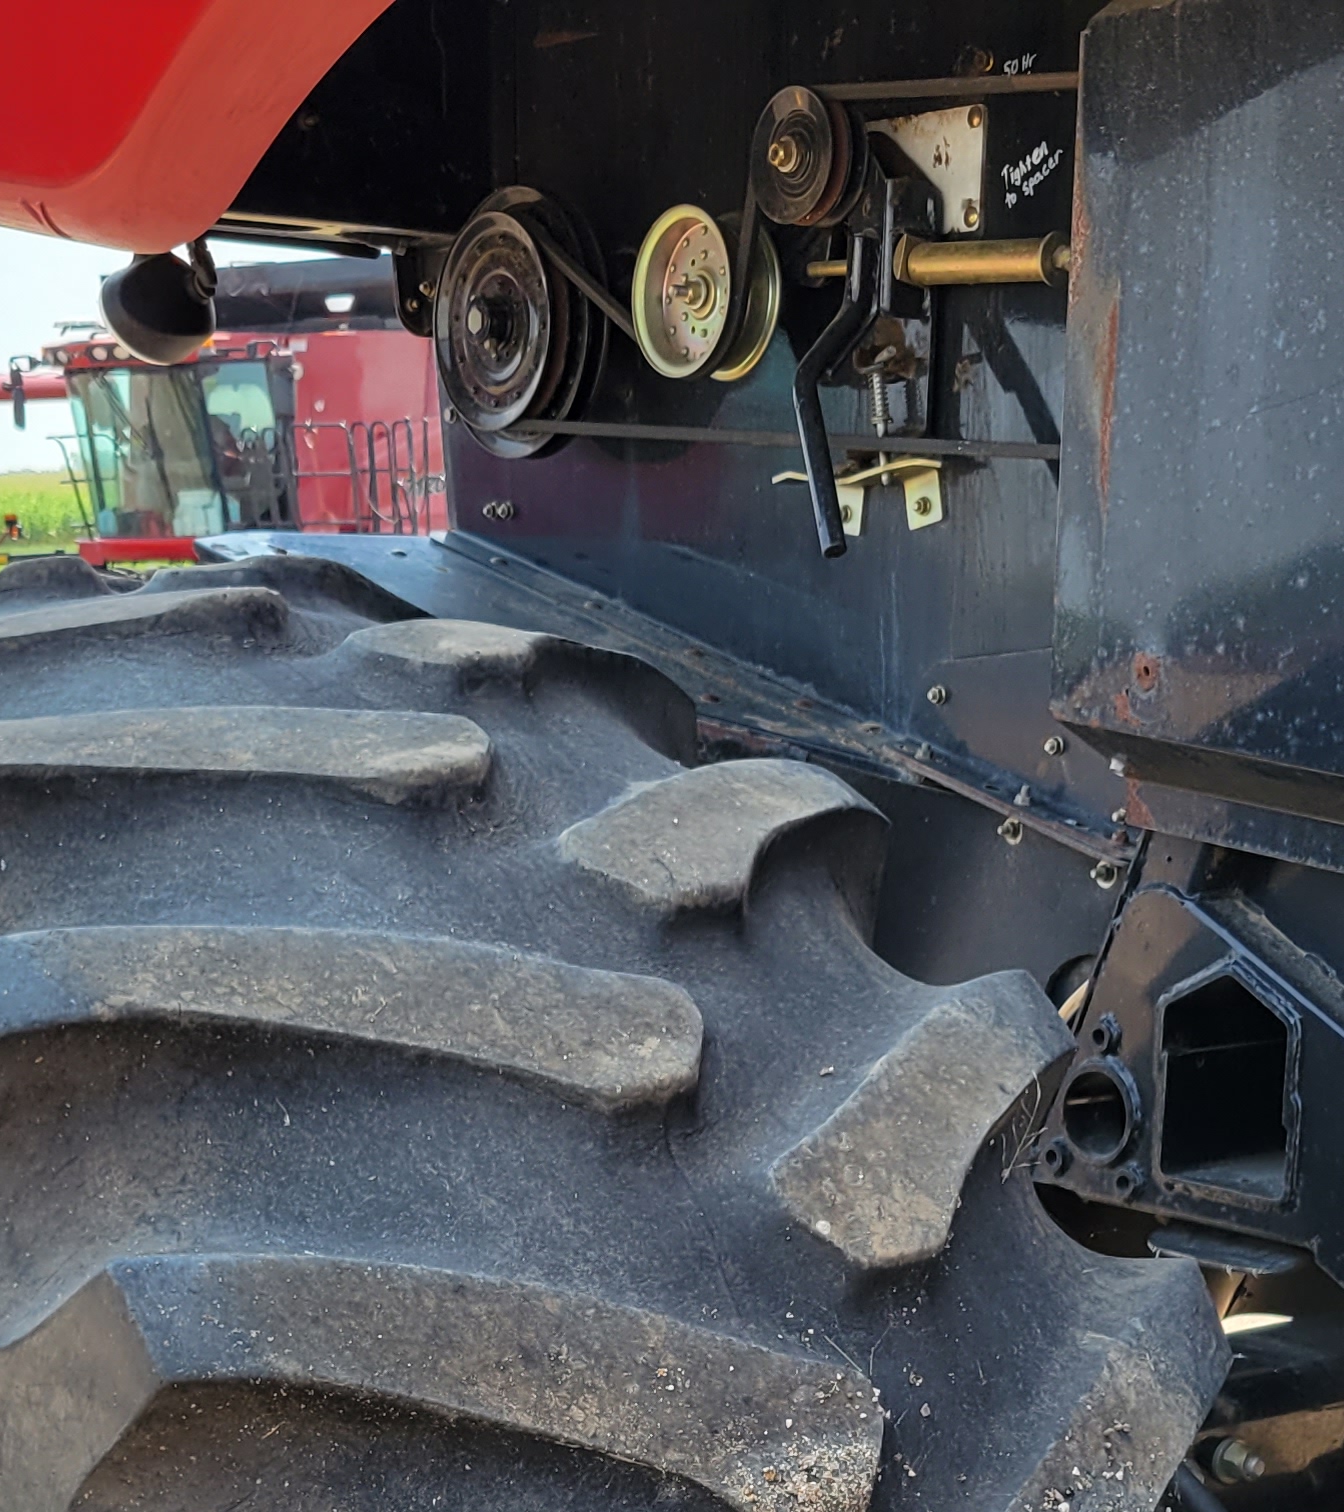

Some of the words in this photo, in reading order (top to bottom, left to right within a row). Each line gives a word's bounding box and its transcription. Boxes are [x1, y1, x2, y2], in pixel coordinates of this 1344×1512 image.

[1003, 58, 1019, 78] 50
[1000, 141, 1049, 190] Tighten
[1005, 192, 1017, 209] to
[1022, 149, 1064, 196] spacer
